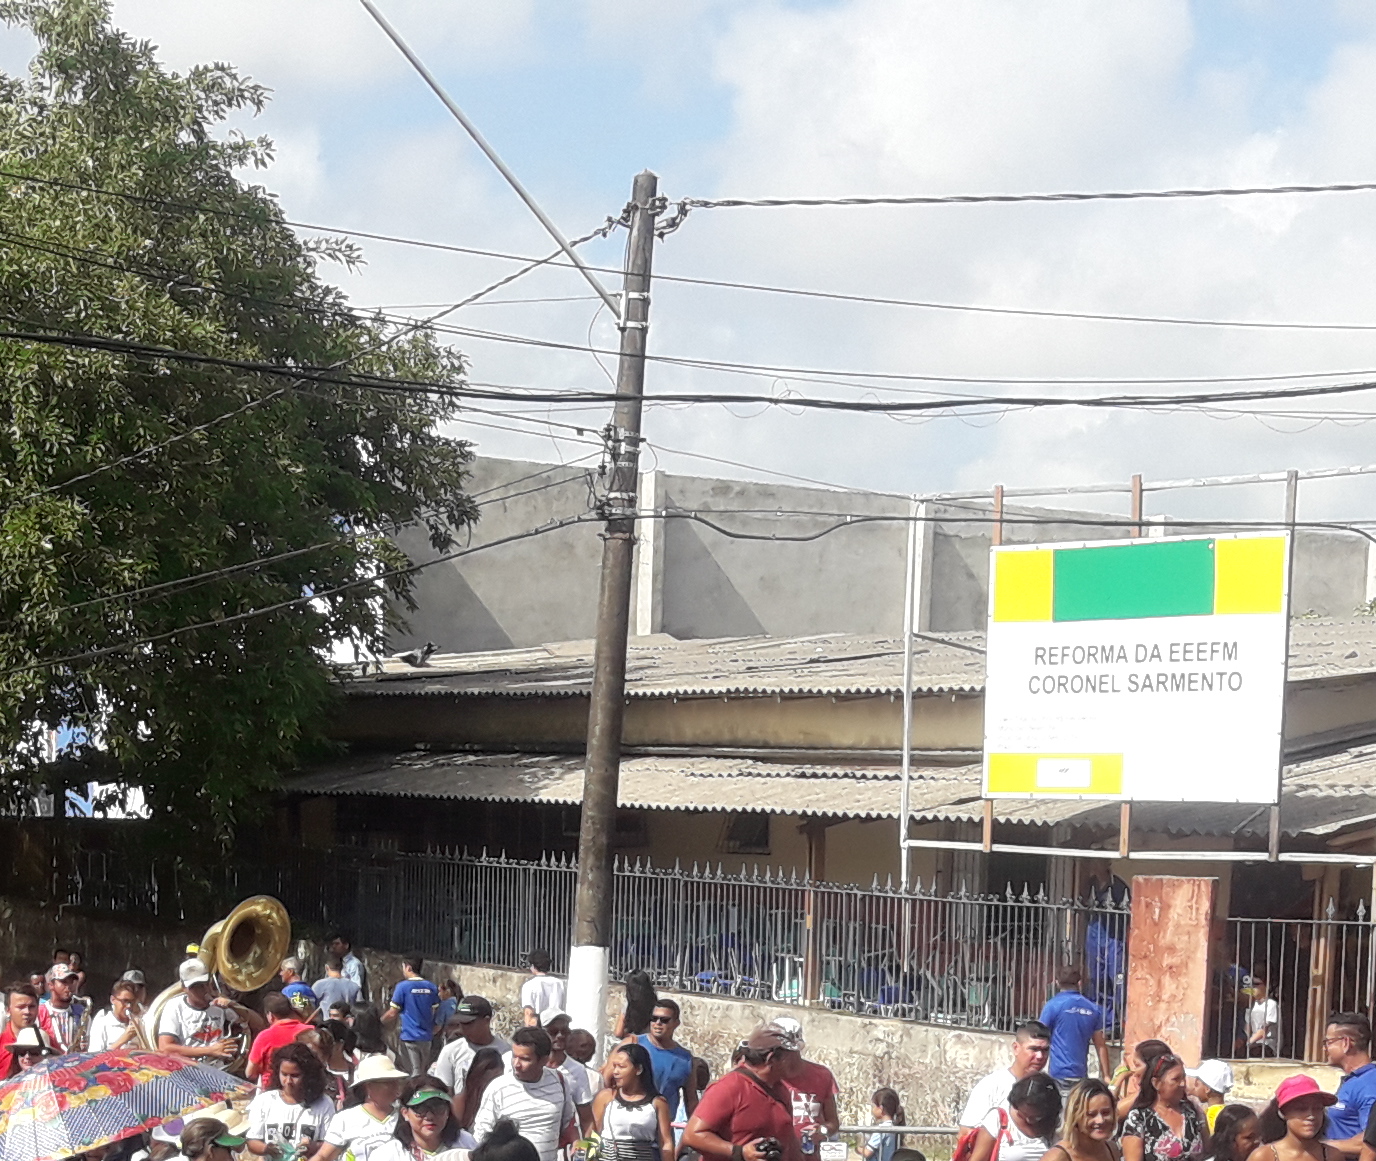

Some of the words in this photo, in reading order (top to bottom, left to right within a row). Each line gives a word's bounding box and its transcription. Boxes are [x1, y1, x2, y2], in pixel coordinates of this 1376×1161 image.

[1034, 644, 1129, 666] REFORMA
[1135, 643, 1163, 663] DA
[1169, 641, 1239, 662] EEEFM
[1028, 674, 1122, 694] CORONEL
[1127, 672, 1243, 693] SARMENTO
